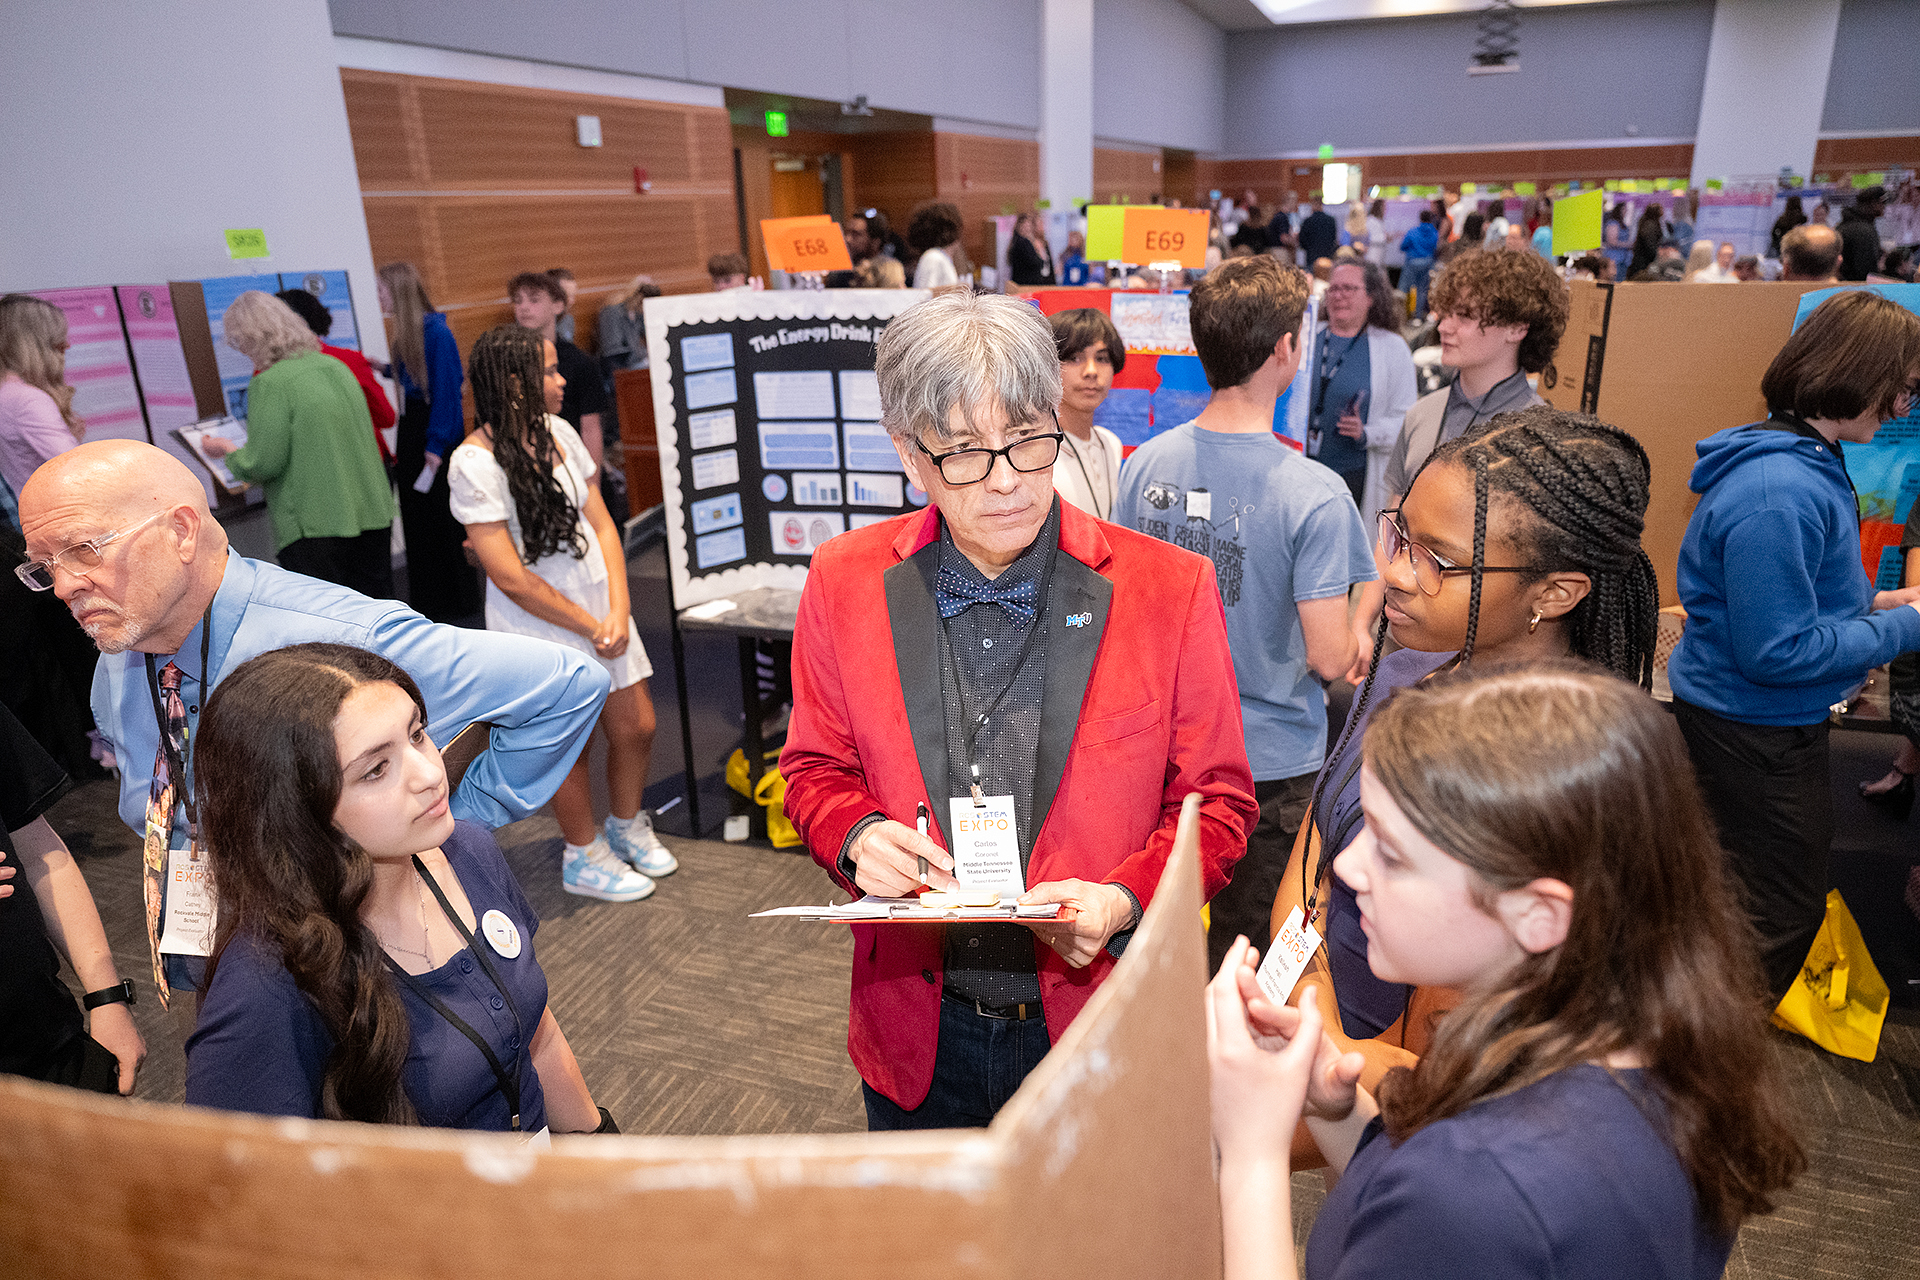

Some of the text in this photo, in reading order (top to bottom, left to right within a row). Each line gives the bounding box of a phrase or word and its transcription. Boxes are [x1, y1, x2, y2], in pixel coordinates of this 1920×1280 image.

[793, 238, 829, 257] E68
[1145, 230, 1184, 252] E69
[748, 334, 779, 353] The
[777, 327, 830, 346] Energy
[830, 322, 872, 343] Drink
[960, 819, 1008, 831] EXPO
[1281, 928, 1305, 963] EXPO
